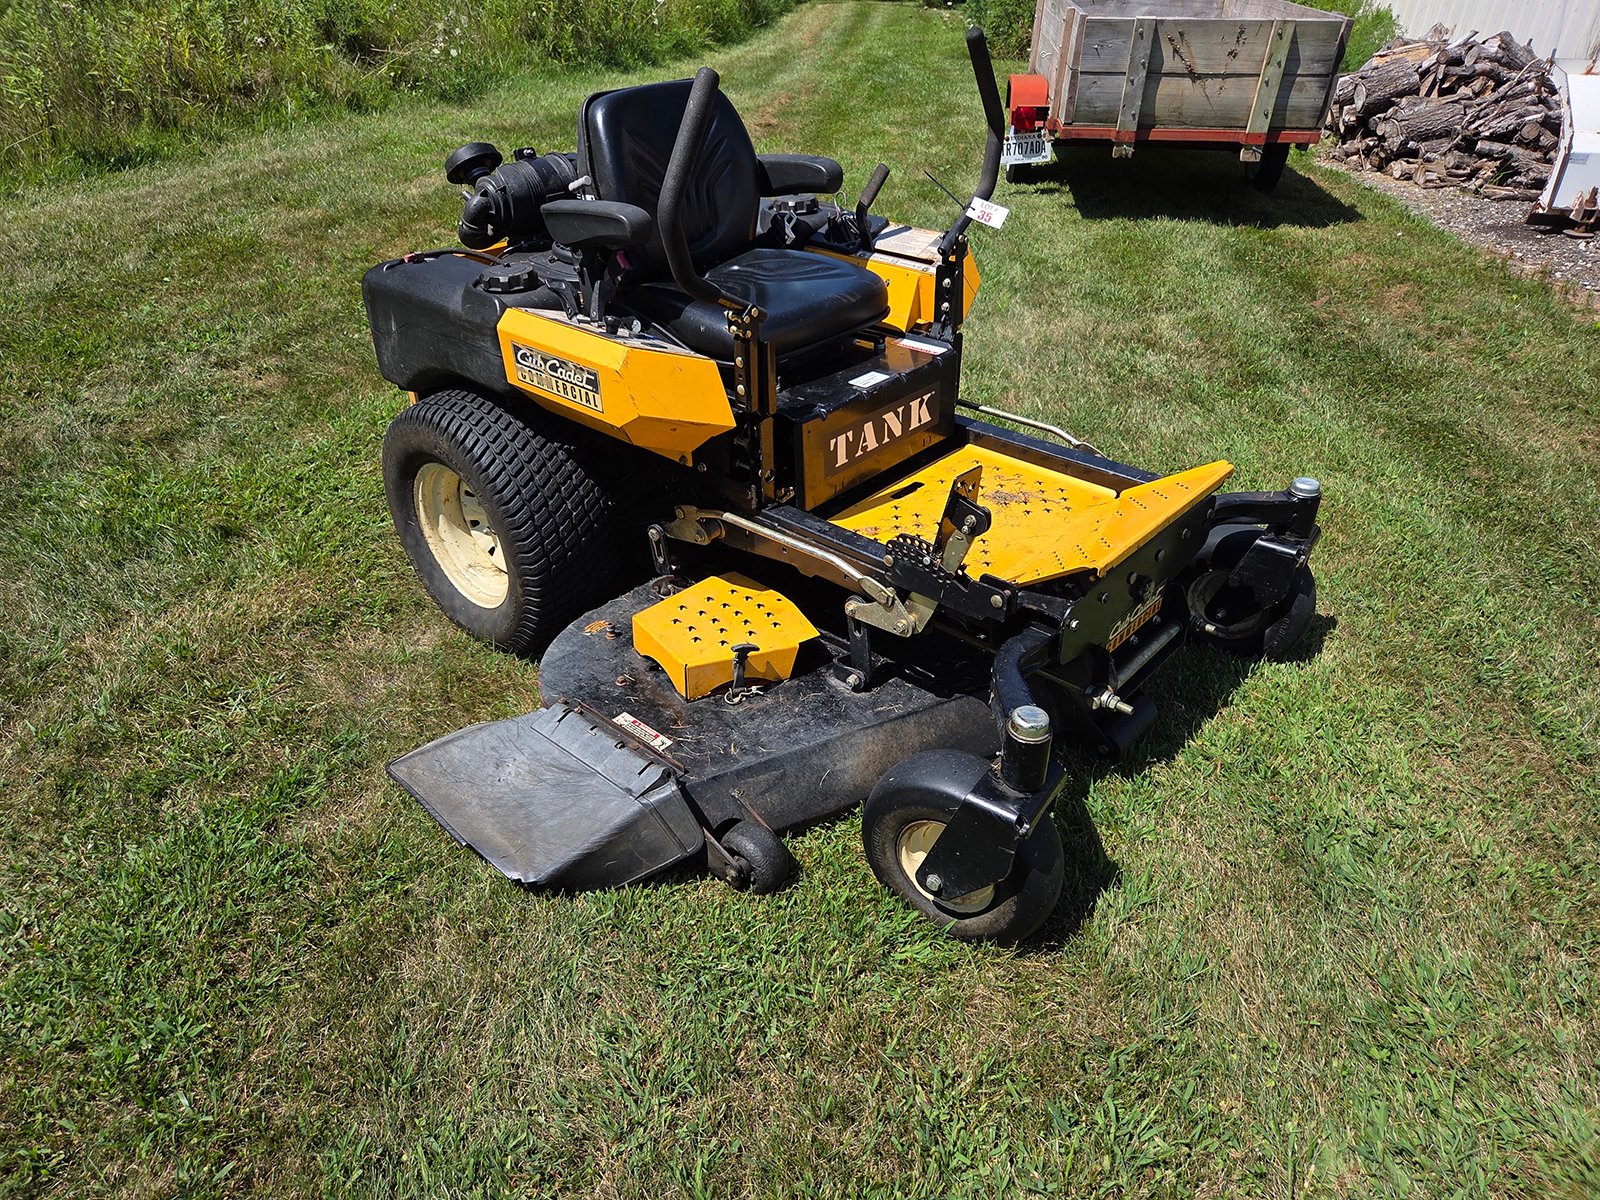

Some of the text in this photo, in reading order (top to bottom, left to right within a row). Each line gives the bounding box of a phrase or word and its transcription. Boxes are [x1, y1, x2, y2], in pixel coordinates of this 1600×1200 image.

[977, 209, 994, 223] 35
[980, 202, 994, 211] LOT
[517, 349, 596, 391] Cub Cadet
[517, 366, 599, 408] COMMERCIAL
[830, 392, 932, 468] TANK
